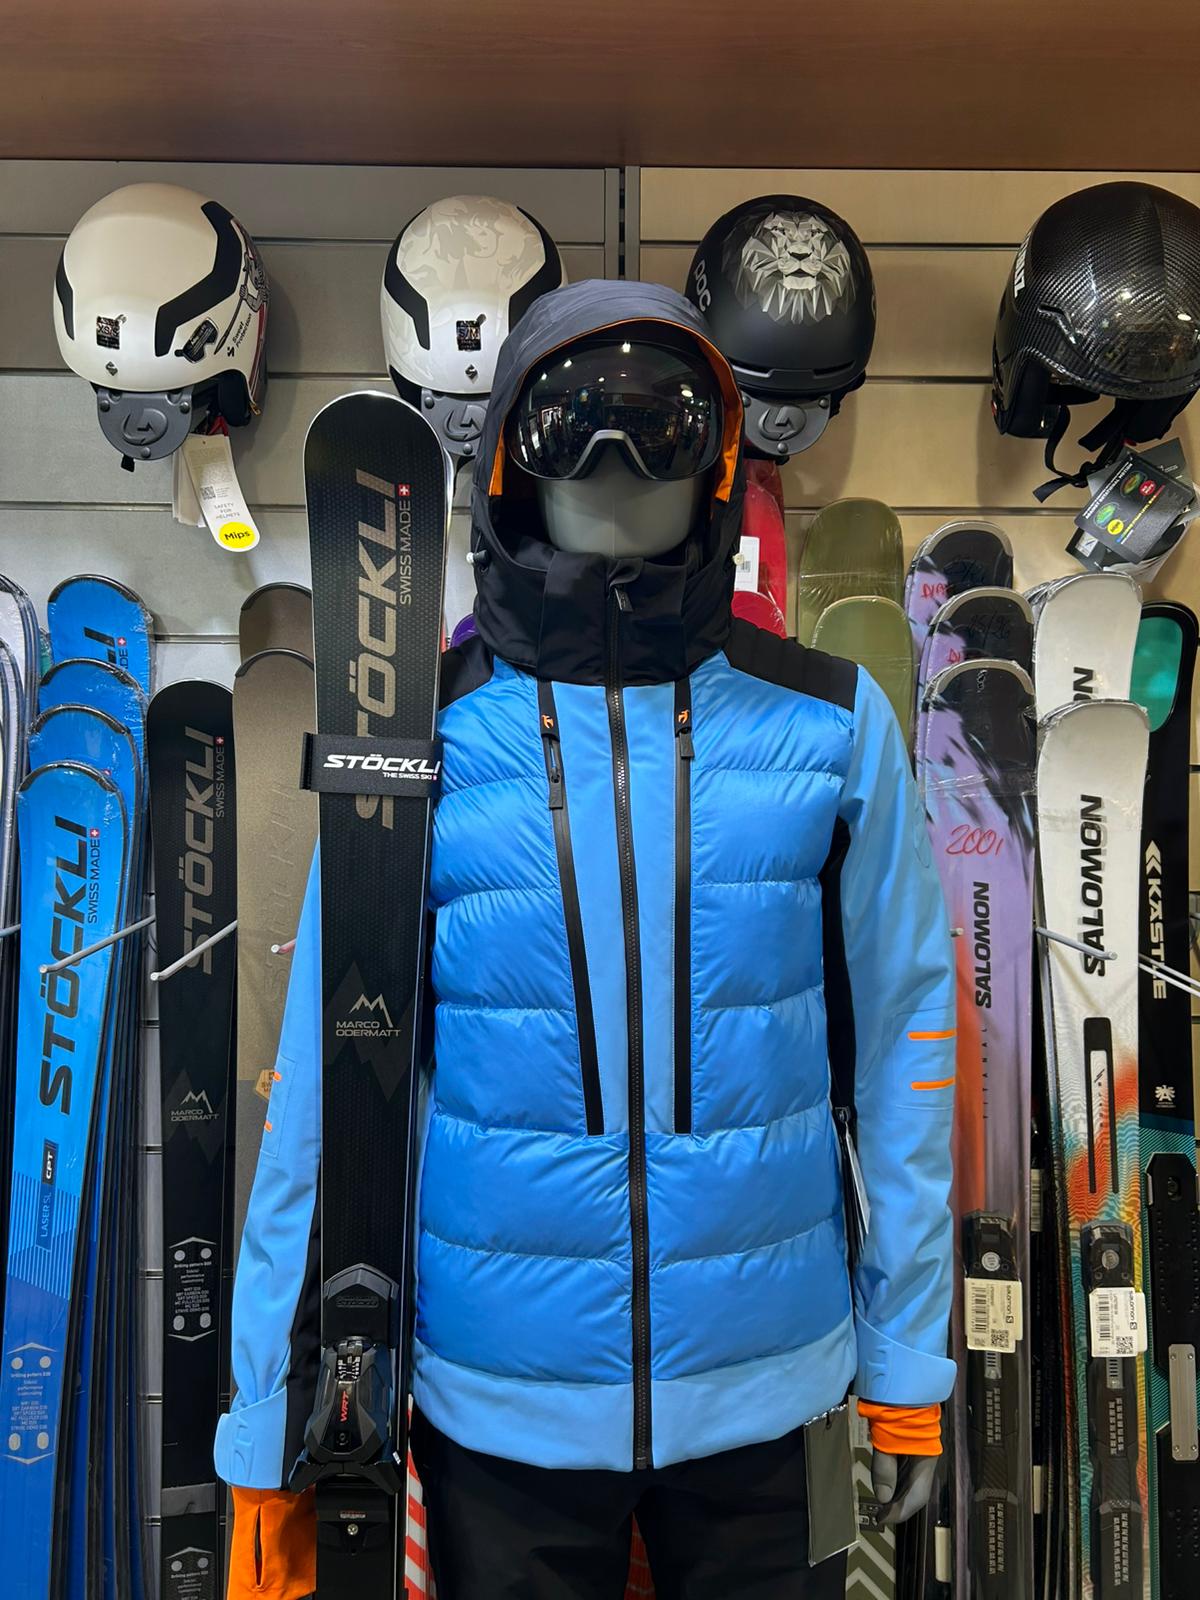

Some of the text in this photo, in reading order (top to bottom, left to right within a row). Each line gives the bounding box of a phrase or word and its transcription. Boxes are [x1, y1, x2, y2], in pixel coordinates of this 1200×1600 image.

[693, 259, 712, 312] POC
[224, 530, 251, 541] Mips
[399, 499, 413, 606] SWISS MADE
[215, 747, 226, 818] SWISS MADE
[323, 753, 441, 774] STÖCKLI
[179, 726, 215, 976] STÖCKLI
[88, 838, 101, 925] SWISS MADE
[1079, 794, 1107, 978] SALOMON
[973, 881, 992, 1009] SALOMON
[38, 816, 88, 1116] STÖCKLI
[336, 1020, 380, 1028] MARCO
[336, 1028, 401, 1037] ODERMATT
[170, 1108, 204, 1116] MARCO
[170, 1113, 220, 1122] ODERMATT
[44, 1150, 54, 1180] CPT
[39, 1192, 53, 1238] LASER SL
[1005, 1285, 1013, 1314] salomon
[340, 1390, 349, 1422] WRT
